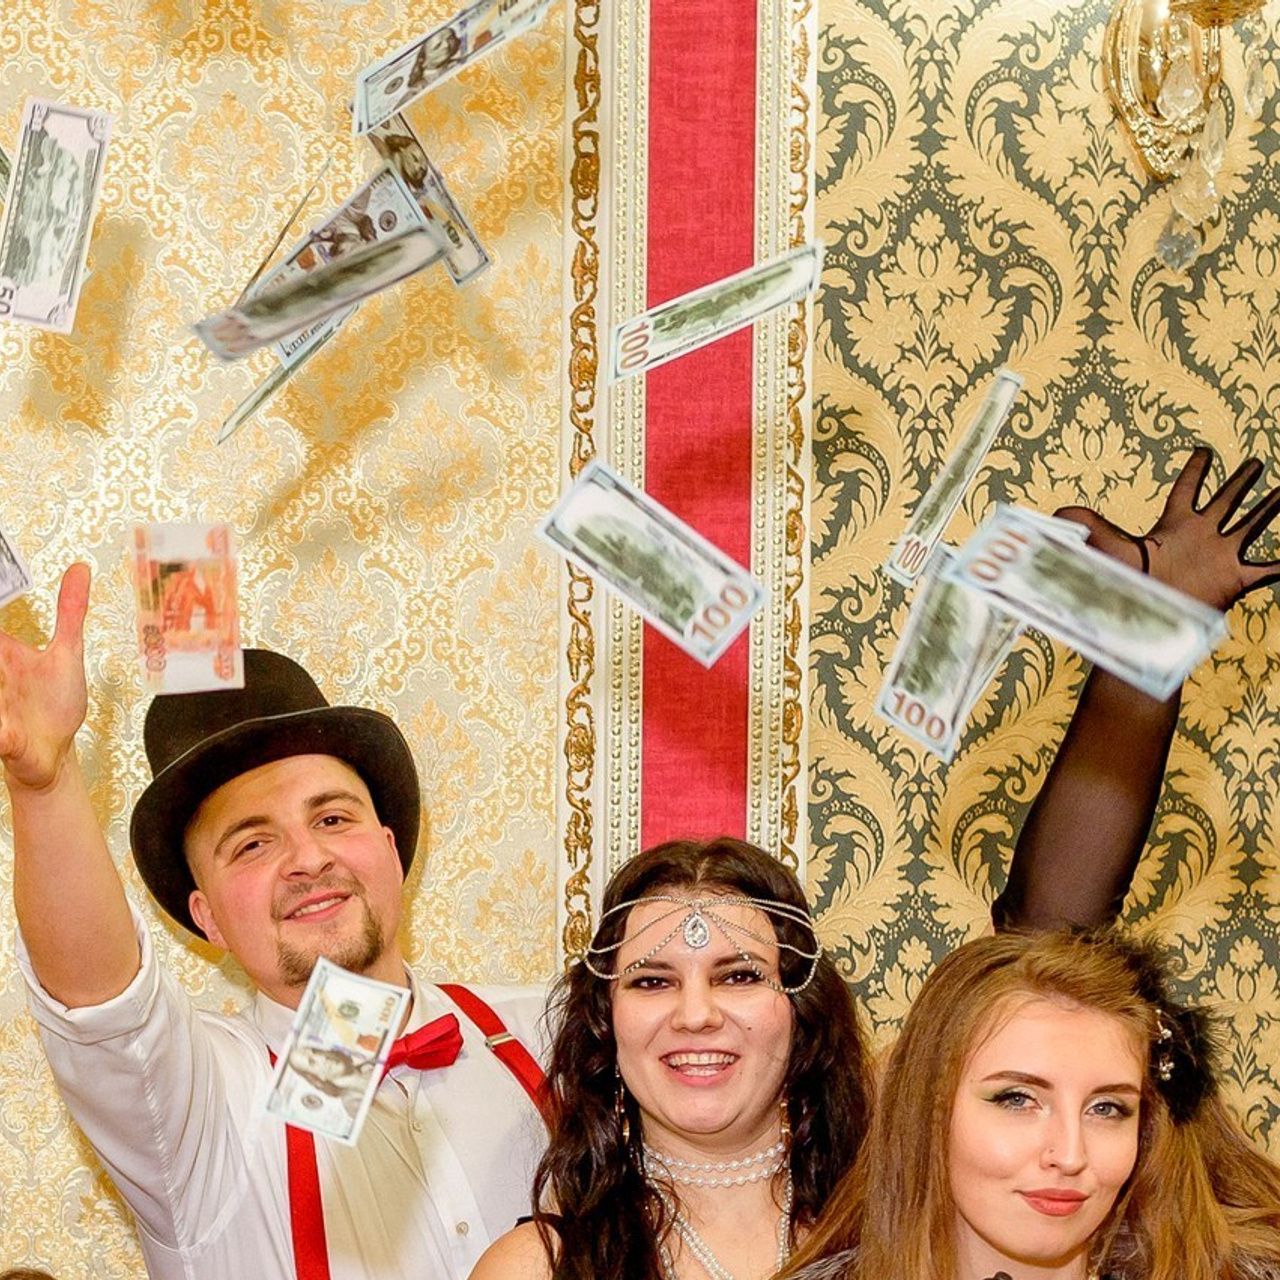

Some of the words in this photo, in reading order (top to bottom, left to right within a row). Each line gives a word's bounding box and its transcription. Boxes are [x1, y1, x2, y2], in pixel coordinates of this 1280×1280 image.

[619, 321, 650, 370] 100
[896, 538, 929, 575] 100
[967, 529, 1031, 584] 100
[690, 584, 748, 643] 100
[890, 692, 947, 742] 100
